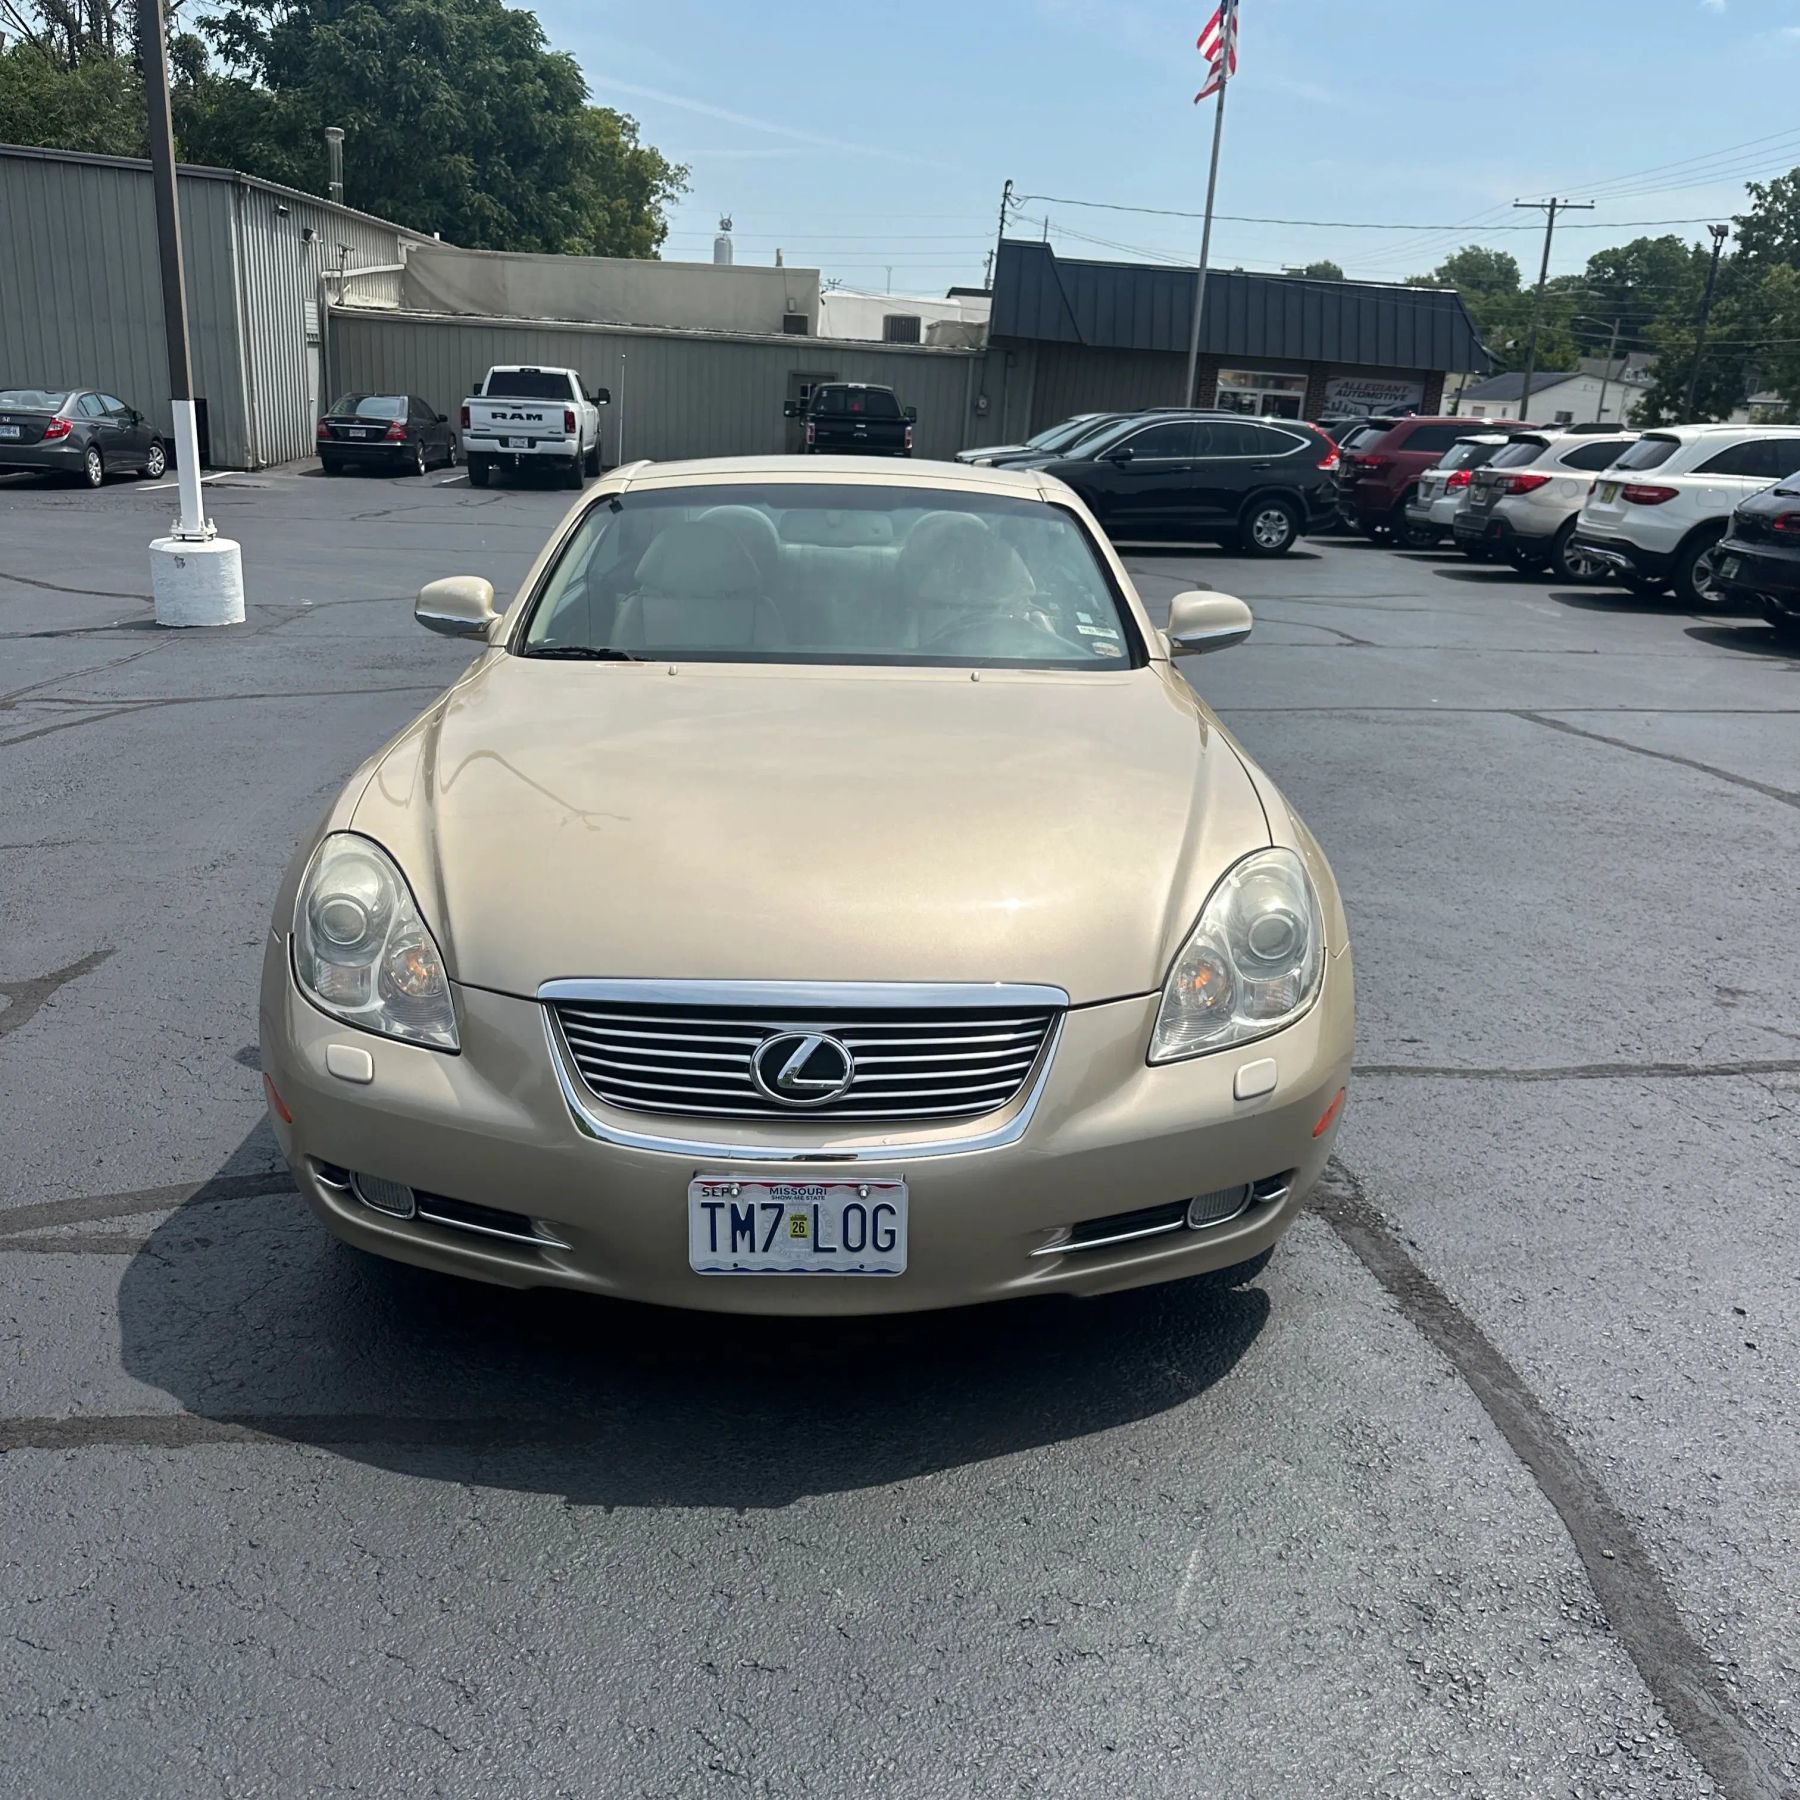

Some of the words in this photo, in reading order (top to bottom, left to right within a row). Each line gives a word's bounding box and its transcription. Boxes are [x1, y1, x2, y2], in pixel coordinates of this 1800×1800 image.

[1340, 381, 1409, 394] ALLEGIANT
[1334, 389, 1409, 402] AUTOMOTIVE
[491, 412, 543, 421] RAM
[701, 1186, 730, 1198] SEP
[769, 1187, 828, 1196] MISSOURI
[700, 1202, 785, 1253] TM7
[792, 1221, 805, 1234] 26
